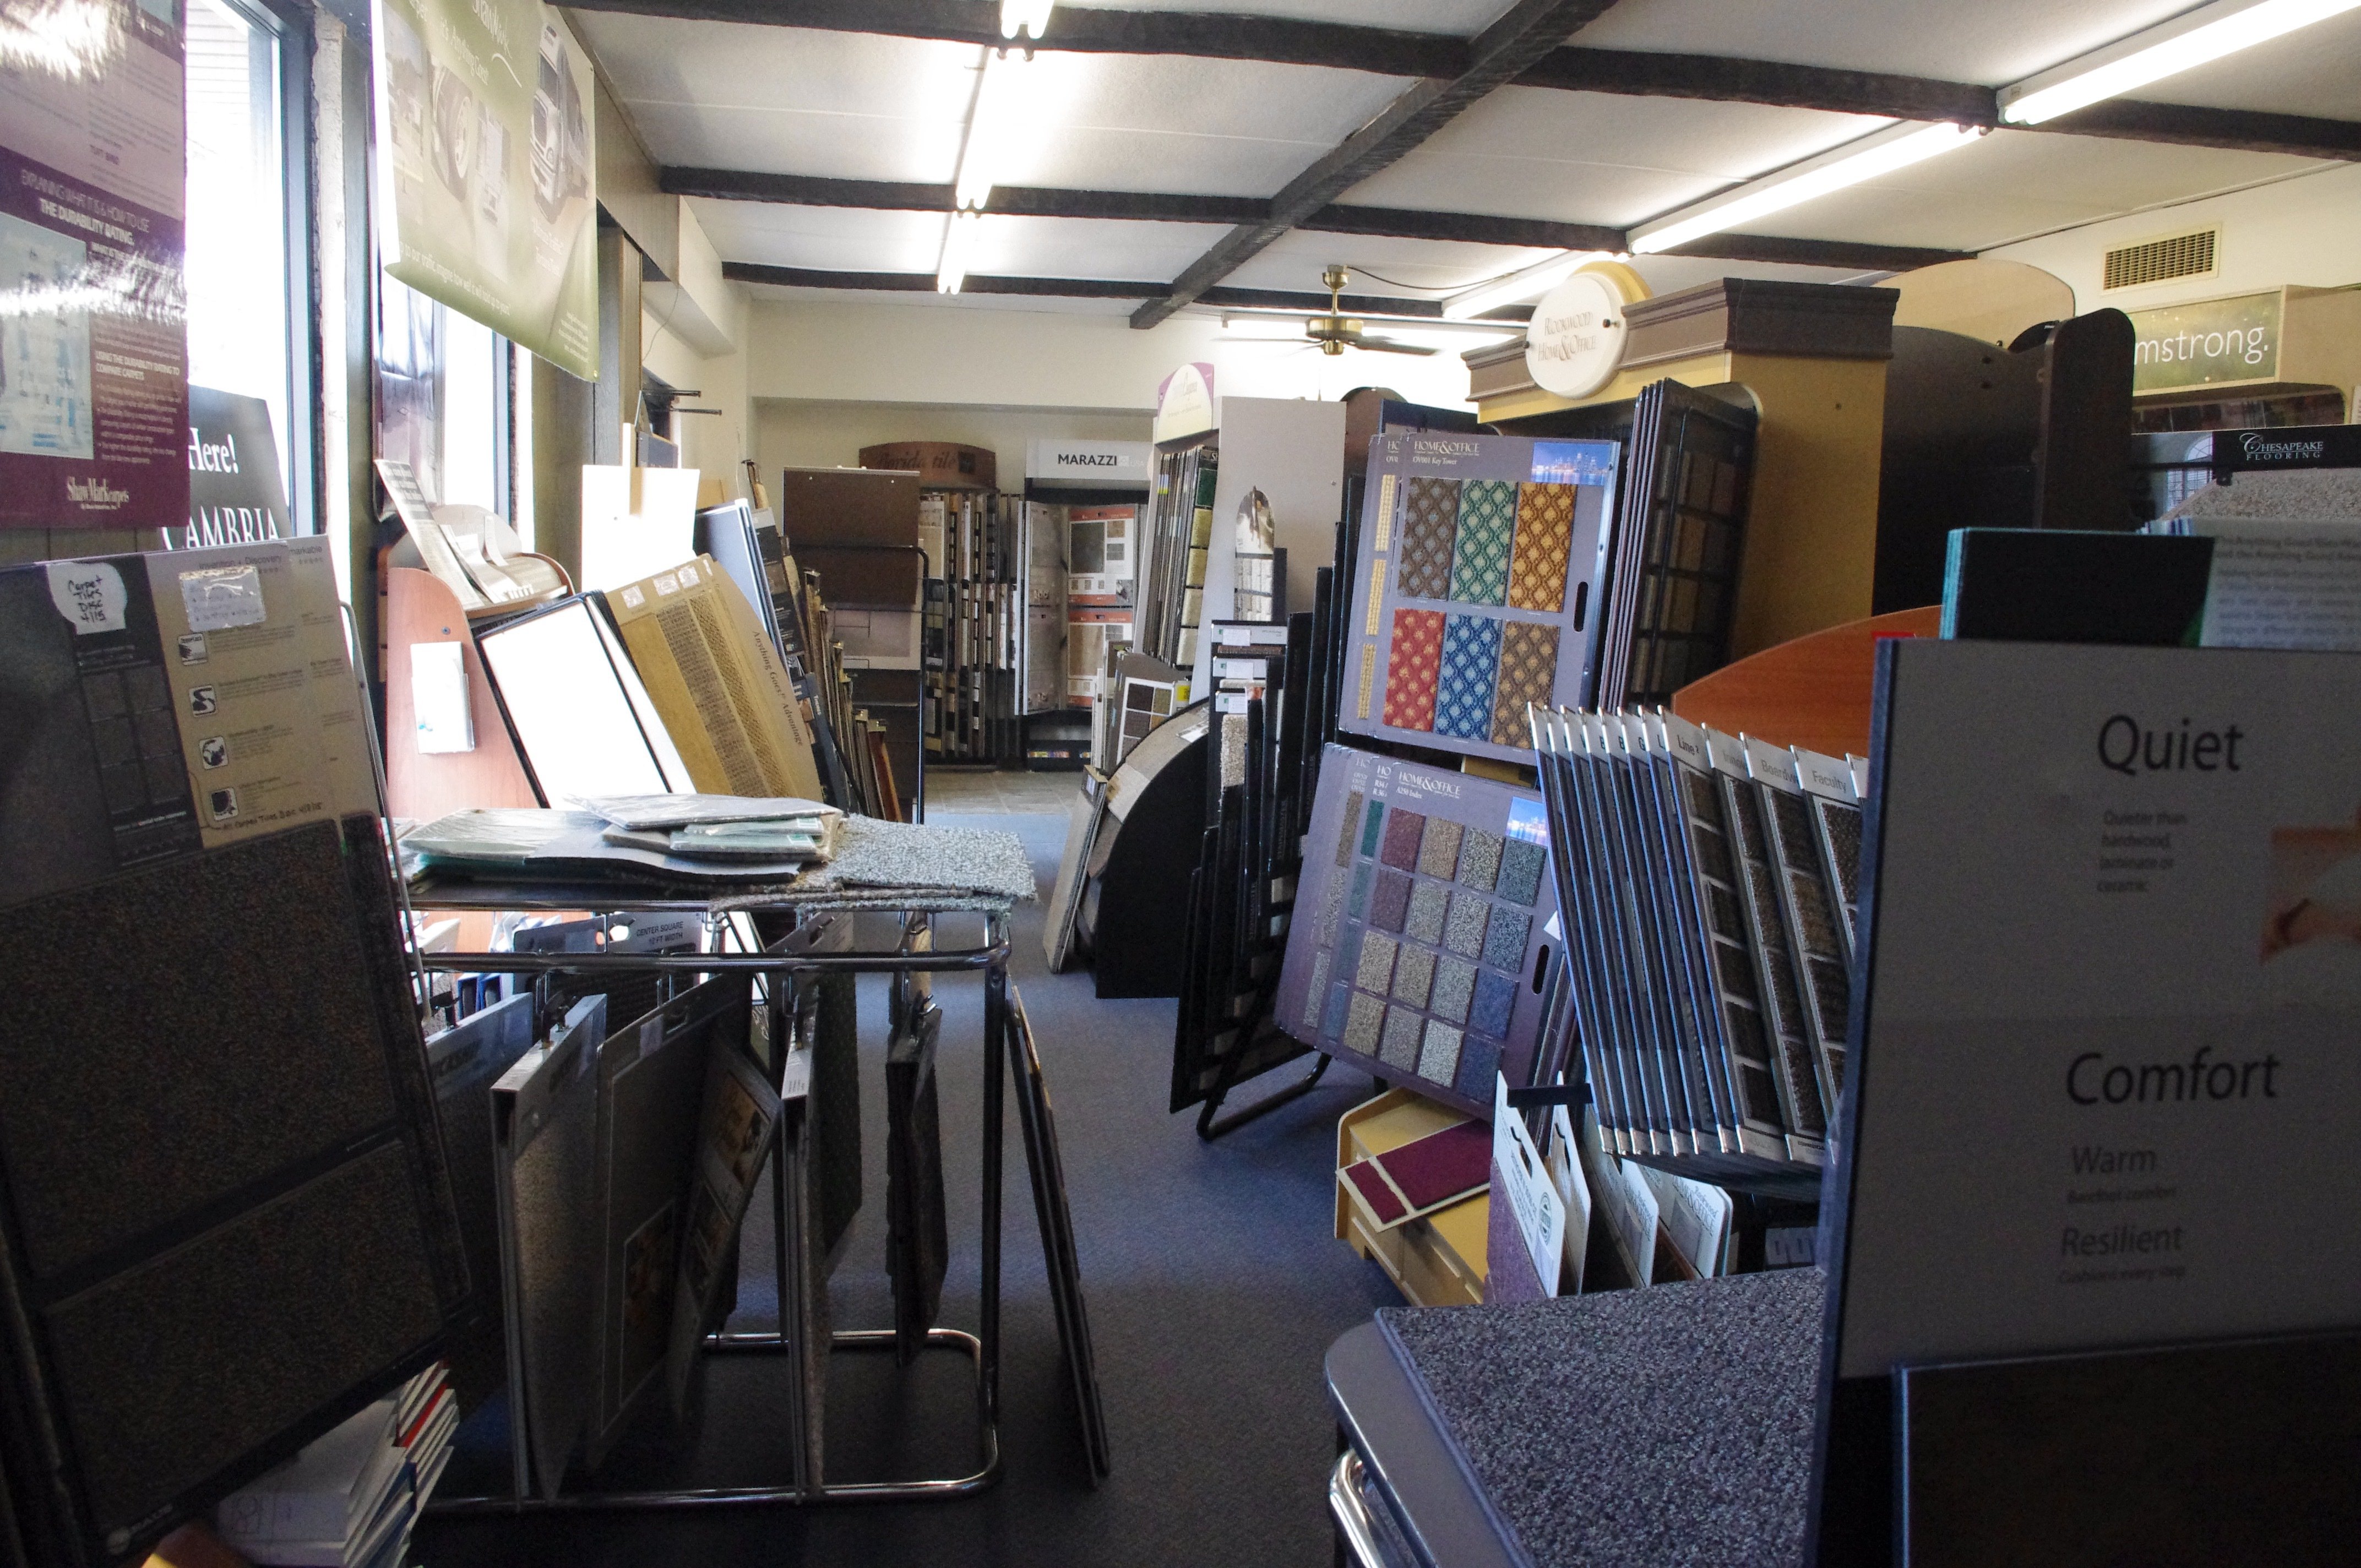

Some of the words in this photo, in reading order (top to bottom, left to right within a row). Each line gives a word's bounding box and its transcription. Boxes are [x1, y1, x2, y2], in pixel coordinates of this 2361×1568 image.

[39, 197, 57, 217] THE
[58, 205, 103, 235] DURABILITY
[2239, 432, 2324, 454] CHESAPEAKE
[1058, 454, 1117, 466] MARAZZI
[1432, 458, 1441, 466] Key
[2246, 451, 2321, 461] FLOORING
[753, 630, 771, 671] Anything
[782, 703, 803, 747] Advantage
[2097, 714, 2244, 776] Quiet
[1813, 771, 1846, 793] Faculty
[636, 925, 659, 937] CENTER
[660, 921, 683, 932] SQUARE
[665, 932, 683, 941] WIDTH
[2066, 1046, 2281, 1106] Comfort
[2071, 1145, 2157, 1174] Warm
[2061, 1224, 2184, 1257] Resilient
